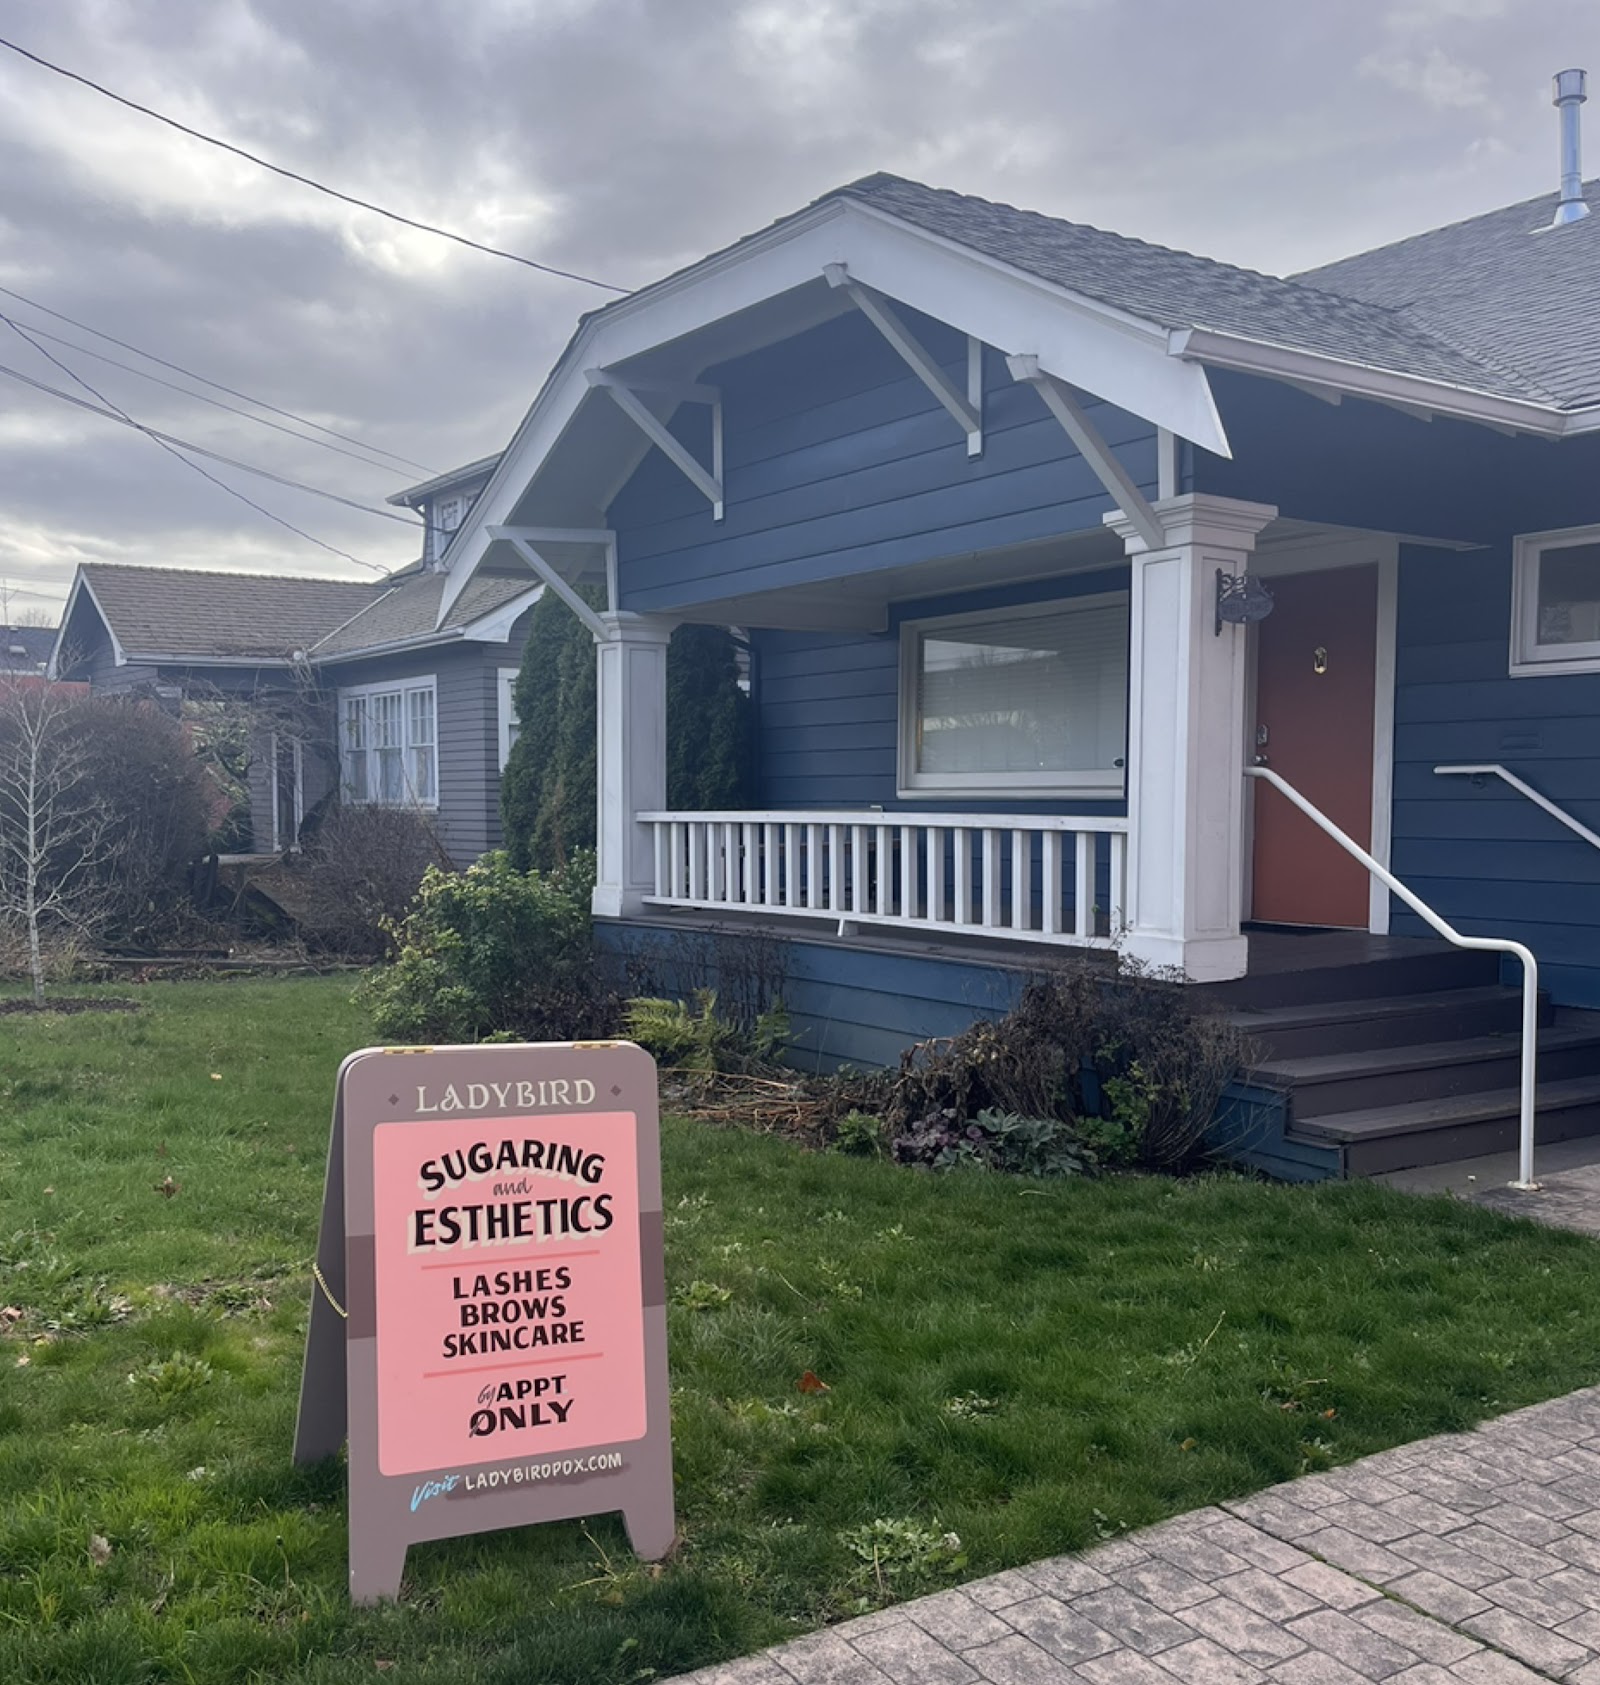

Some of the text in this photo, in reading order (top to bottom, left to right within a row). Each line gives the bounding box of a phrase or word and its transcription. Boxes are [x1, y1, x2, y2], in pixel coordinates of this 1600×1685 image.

[415, 1078, 596, 1113] LADYBIRD
[420, 1139, 605, 1192] SUGARING
[493, 1178, 533, 1196] and
[415, 1194, 613, 1247] ESTHETICS
[453, 1266, 572, 1299] LASHES
[460, 1296, 567, 1328] BROWS
[442, 1321, 585, 1359] SKINCARE
[469, 1398, 575, 1437] ONLY
[410, 1452, 622, 1512] Visit LADYBIRDPDX.COM
